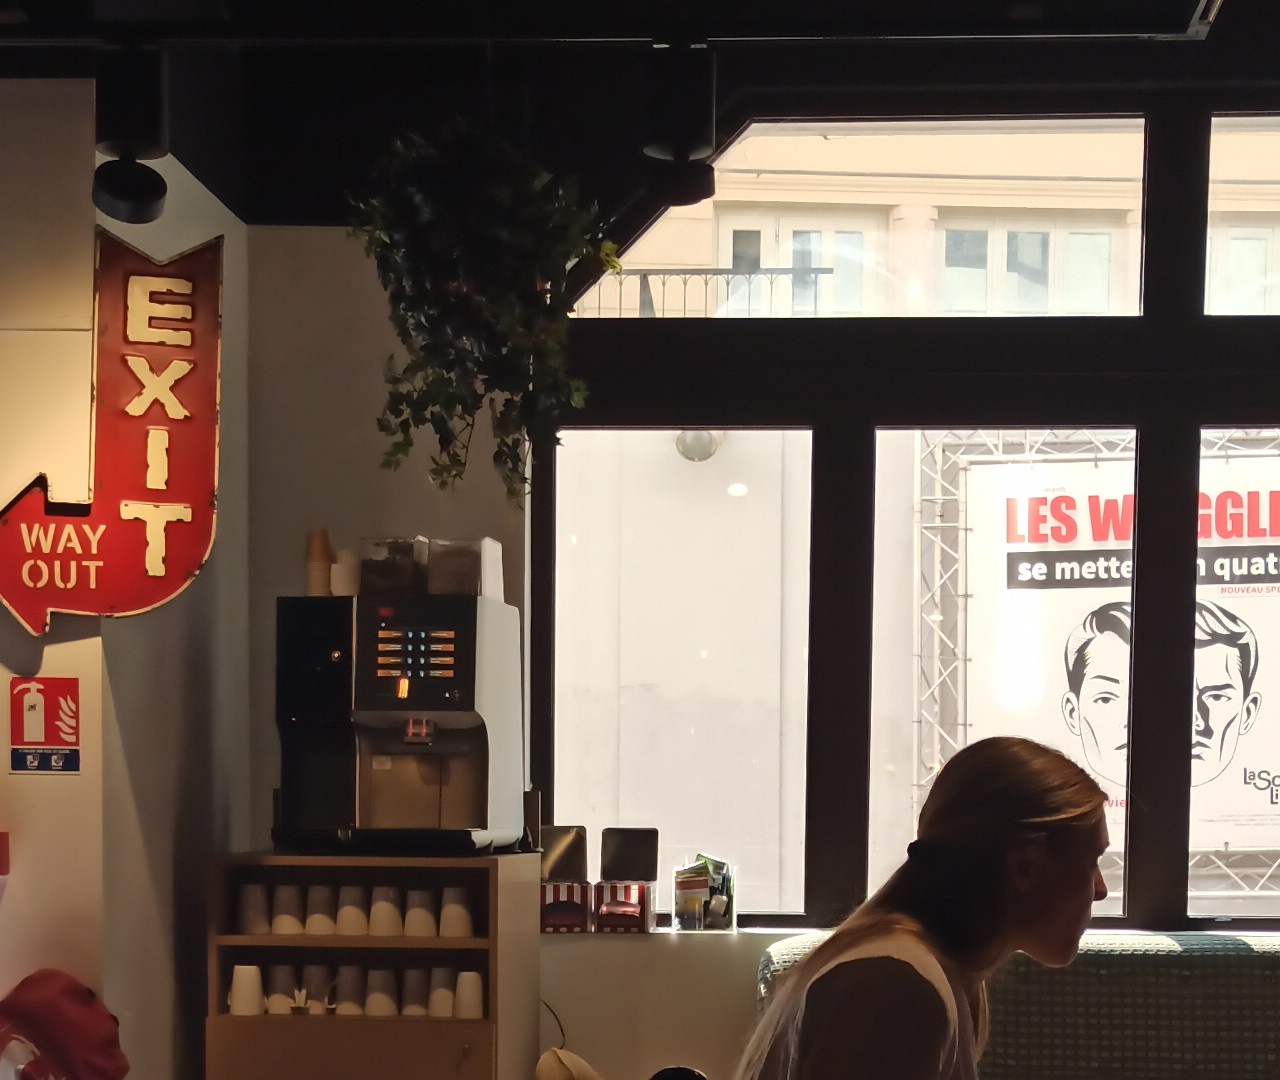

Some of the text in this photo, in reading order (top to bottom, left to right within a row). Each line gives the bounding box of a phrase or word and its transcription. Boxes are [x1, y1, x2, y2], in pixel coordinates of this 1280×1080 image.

[120, 275, 195, 577] EXIT
[1006, 495, 1078, 543] LES
[20, 523, 106, 555] WAY
[21, 559, 104, 590] OUT
[1017, 562, 1048, 581] se
[1055, 556, 1133, 580] mette
[1220, 586, 1263, 594] NOUVEAU
[1243, 767, 1256, 785] La
